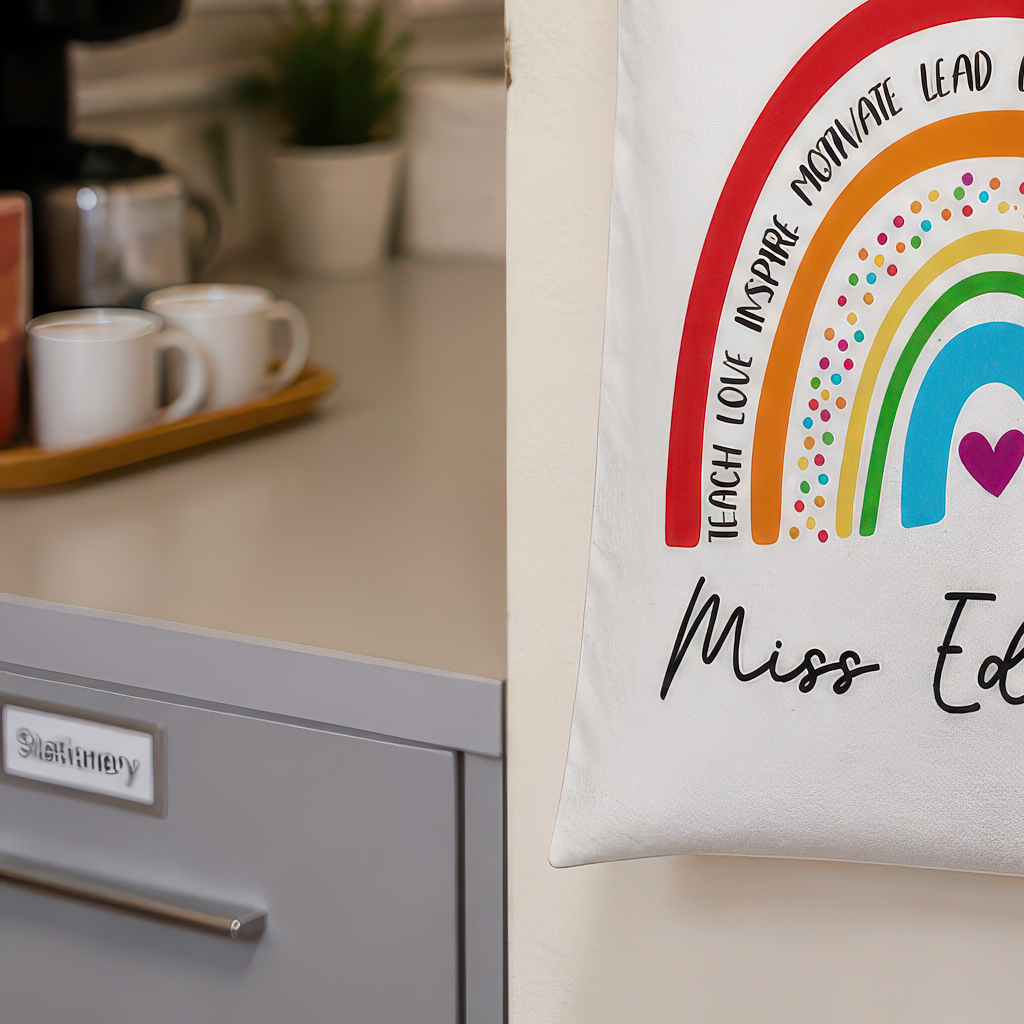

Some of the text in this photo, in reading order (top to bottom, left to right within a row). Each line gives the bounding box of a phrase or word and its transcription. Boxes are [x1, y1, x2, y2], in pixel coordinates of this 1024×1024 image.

[920, 49, 992, 102] LEAD
[790, 76, 903, 207] MOTIVATE
[734, 214, 800, 333] INSPIRE
[715, 349, 753, 425] LOVE
[707, 444, 743, 543] TEACH
[659, 576, 881, 701] Miss
